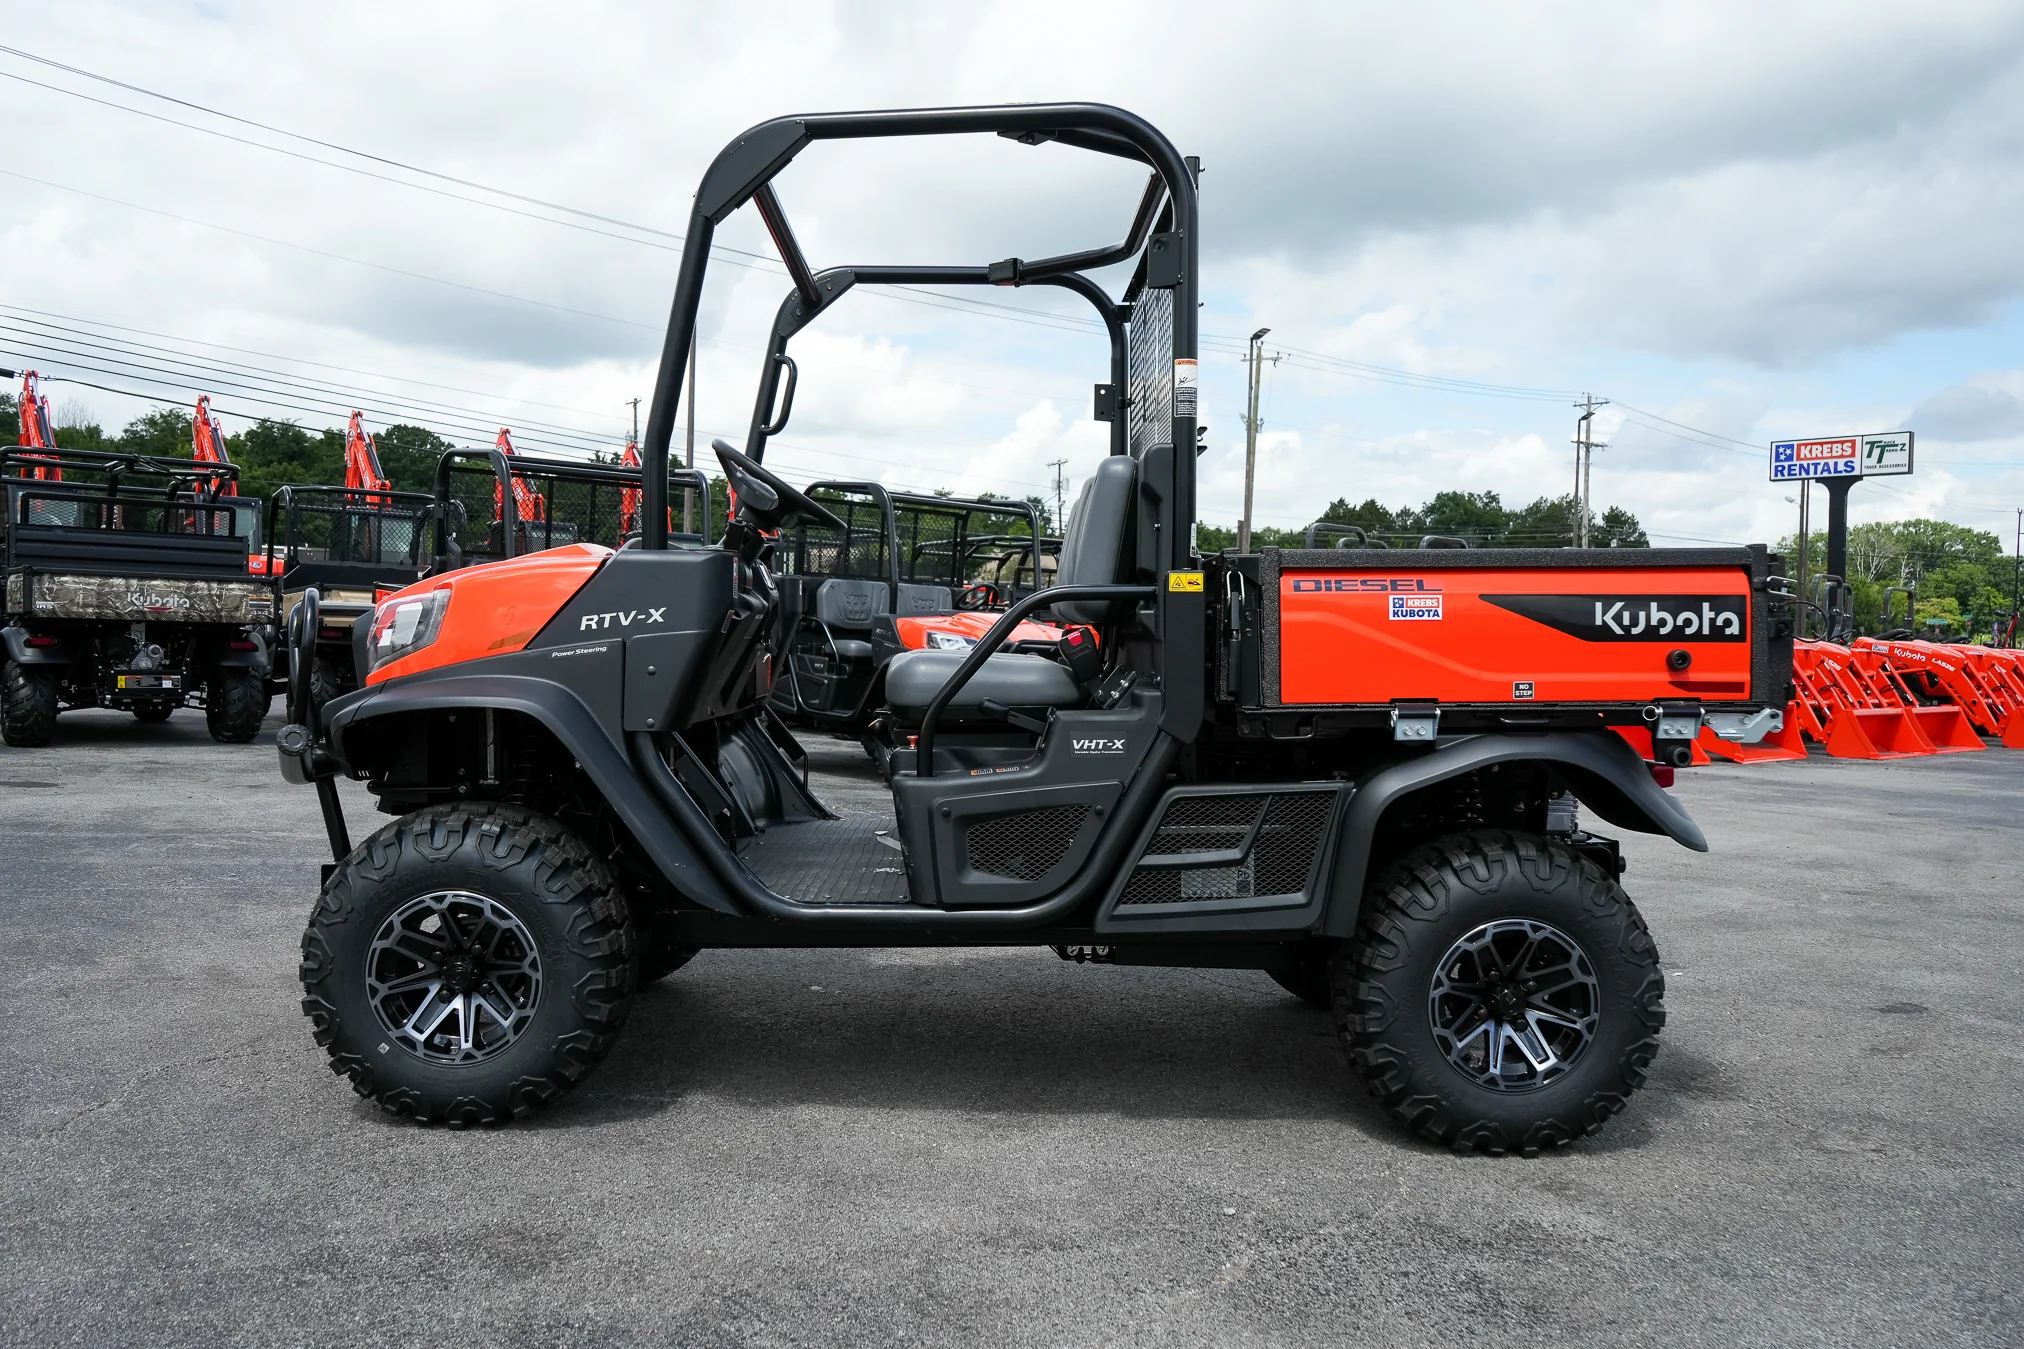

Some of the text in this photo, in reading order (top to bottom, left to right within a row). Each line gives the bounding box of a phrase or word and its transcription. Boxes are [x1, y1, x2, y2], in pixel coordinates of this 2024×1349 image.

[1800, 442, 1852, 458] KREBS
[1774, 460, 1855, 477] RENTALS
[1292, 579, 1443, 592] DIESEL
[127, 592, 189, 608] Kubota
[1407, 599, 1438, 607] KREBS
[579, 607, 667, 631] RTV-X
[1392, 609, 1440, 618] KUBOTA
[1595, 601, 1740, 635] Kubota
[575, 646, 607, 655] Steering
[1894, 648, 1926, 662] Kubota
[1072, 739, 1126, 750] VHT-X
